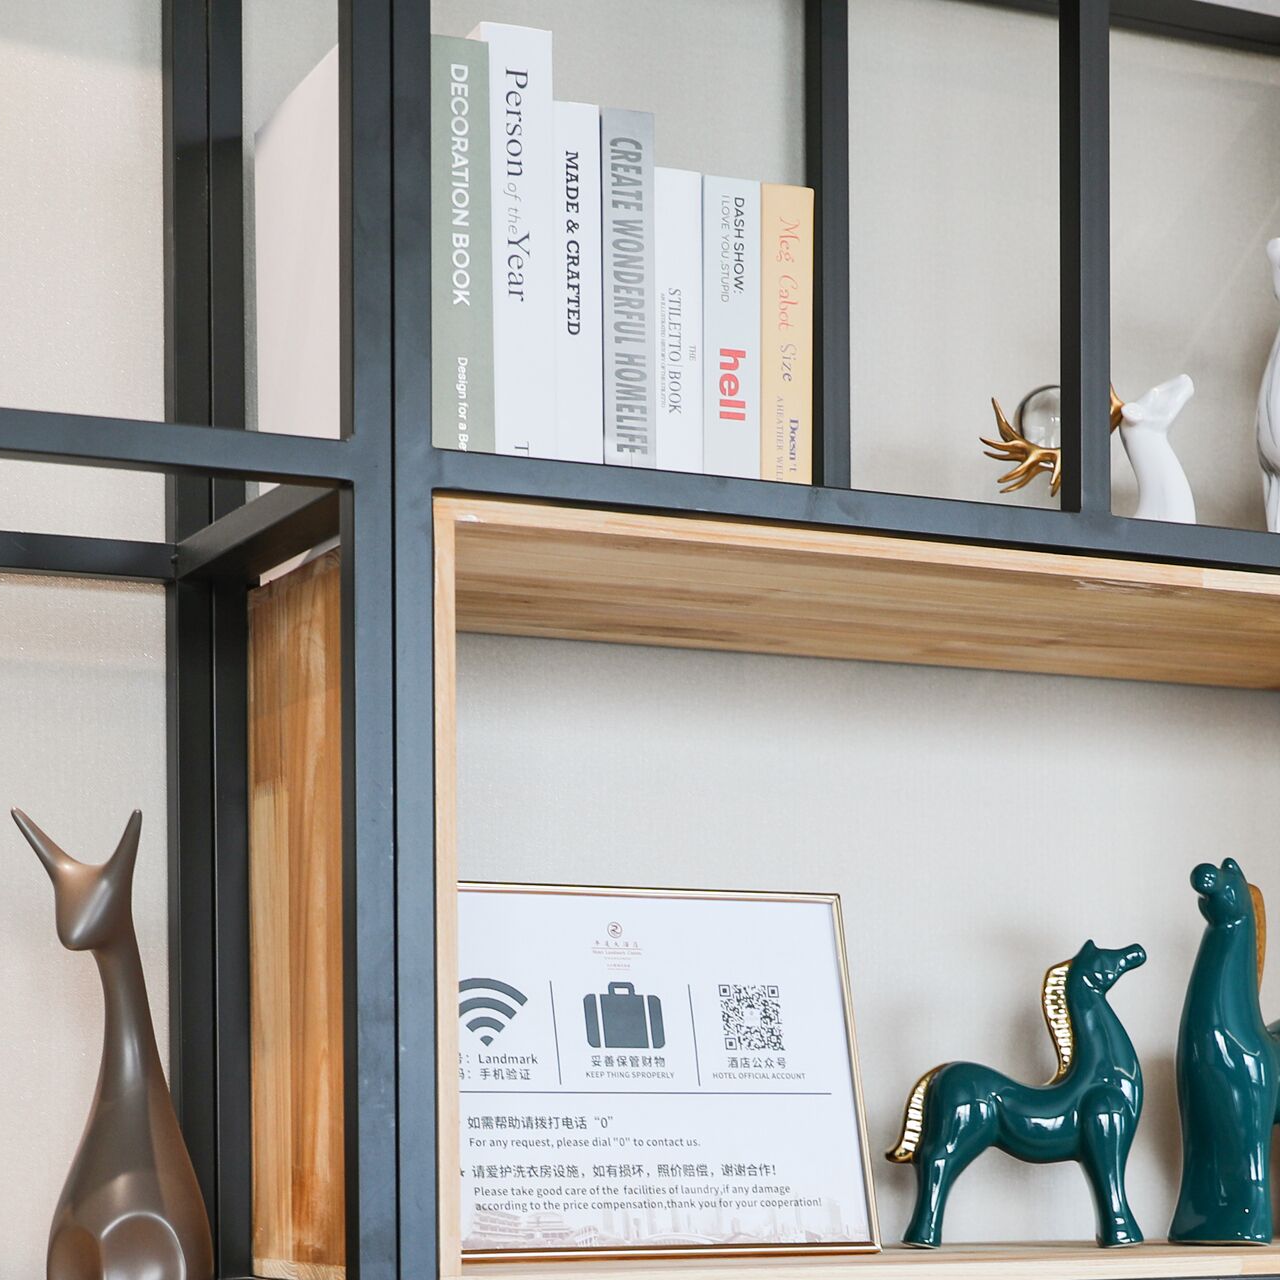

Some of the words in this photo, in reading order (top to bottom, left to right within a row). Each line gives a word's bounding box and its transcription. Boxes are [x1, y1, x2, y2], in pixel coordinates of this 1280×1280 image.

[505, 68, 529, 177] Person
[450, 63, 470, 227] DECORATION
[503, 182, 521, 202] of
[565, 150, 579, 214] MADE
[609, 136, 643, 212] CREATE
[507, 208, 520, 235] the
[566, 219, 580, 234] &
[721, 200, 730, 230] LOVE
[733, 197, 745, 239] DASH
[775, 216, 801, 264] Meg
[452, 233, 471, 307] BOOK
[507, 232, 530, 302] Year
[566, 240, 581, 336] CRAFTED
[612, 219, 646, 344] WONDERFUL
[733, 242, 745, 294] SHOW:
[668, 287, 682, 362] STILETTO
[778, 275, 799, 332] Cabot
[688, 345, 697, 361] THE
[780, 343, 798, 383] Size
[455, 356, 469, 399] Design
[668, 370, 682, 415] BOOK
[719, 348, 746, 421] hell
[458, 402, 469, 420] for
[614, 352, 648, 455] HOMELIFE
[458, 422, 467, 430] a
[458, 433, 469, 452] Be
[788, 419, 799, 472] Doesn't
[478, 1053, 539, 1065] Landmark
[585, 1071, 604, 1079] KEEP
[606, 1071, 631, 1079] THING
[591, 1055, 666, 1068] 妥善保管财物
[712, 1072, 737, 1080] HOTEL
[738, 1072, 770, 1080] OFFICIAL
[771, 1072, 807, 1080] ACCOUNT
[727, 1056, 787, 1069] 酒店公众号
[469, 1137, 487, 1147] For
[489, 1138, 508, 1149] any
[510, 1138, 555, 1149] request,
[556, 1138, 590, 1149] please
[591, 1137, 612, 1147] dial
[633, 1138, 645, 1147] to
[646, 1138, 685, 1147] contact
[686, 1139, 702, 1147] us.
[474, 1186, 509, 1197] Please
[510, 1186, 535, 1196] take
[536, 1186, 563, 1199] good
[564, 1187, 588, 1196] care
[589, 1185, 601, 1195] of
[601, 1185, 619, 1195] the
[623, 1185, 667, 1195] facilities
[668, 1185, 679, 1195] of
[732, 1186, 750, 1197] any
[752, 1184, 791, 1196] damage
[475, 1199, 528, 1212] according
[529, 1200, 541, 1210] to
[542, 1199, 561, 1210] the
[563, 1200, 590, 1212] price
[698, 1199, 717, 1211] you
[718, 1198, 733, 1208] for
[734, 1198, 758, 1210] your
[759, 1197, 823, 1210] cooperation!
